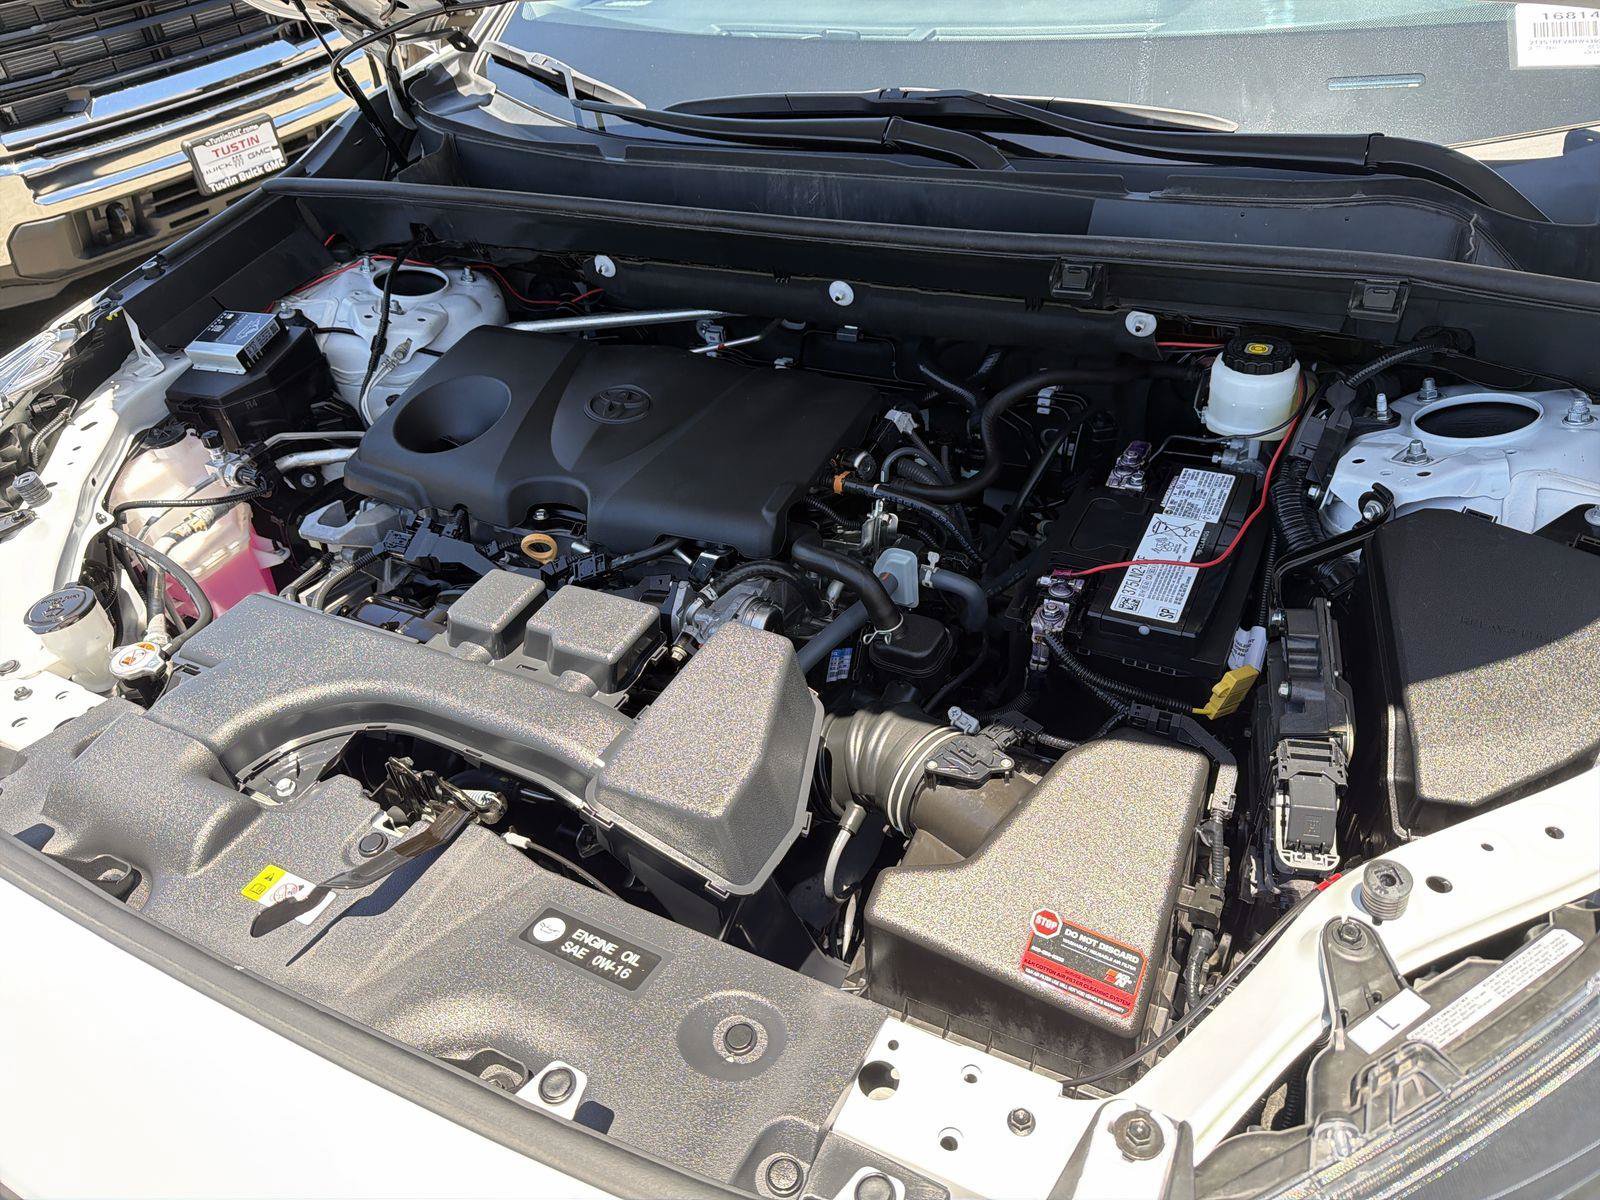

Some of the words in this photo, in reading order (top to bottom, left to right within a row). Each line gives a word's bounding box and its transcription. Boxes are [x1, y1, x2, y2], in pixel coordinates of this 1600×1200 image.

[212, 135, 260, 157] TUSTIN
[247, 146, 271, 160] GMC
[208, 176, 239, 193] Tustin
[238, 165, 265, 182] Buick
[264, 158, 286, 173] GMC
[1121, 555, 1146, 597] 375LN2-F
[1158, 608, 1174, 619] SP
[1034, 915, 1059, 931] STOP
[571, 928, 619, 956] ENGINE
[620, 950, 642, 967] OIL
[1064, 928, 1079, 939] DO
[1079, 934, 1099, 947] NOT
[1098, 940, 1140, 963] DISCARD
[560, 941, 590, 960] SAE
[591, 955, 633, 979] 0W-16
[1376, 1015, 1401, 1030] L
